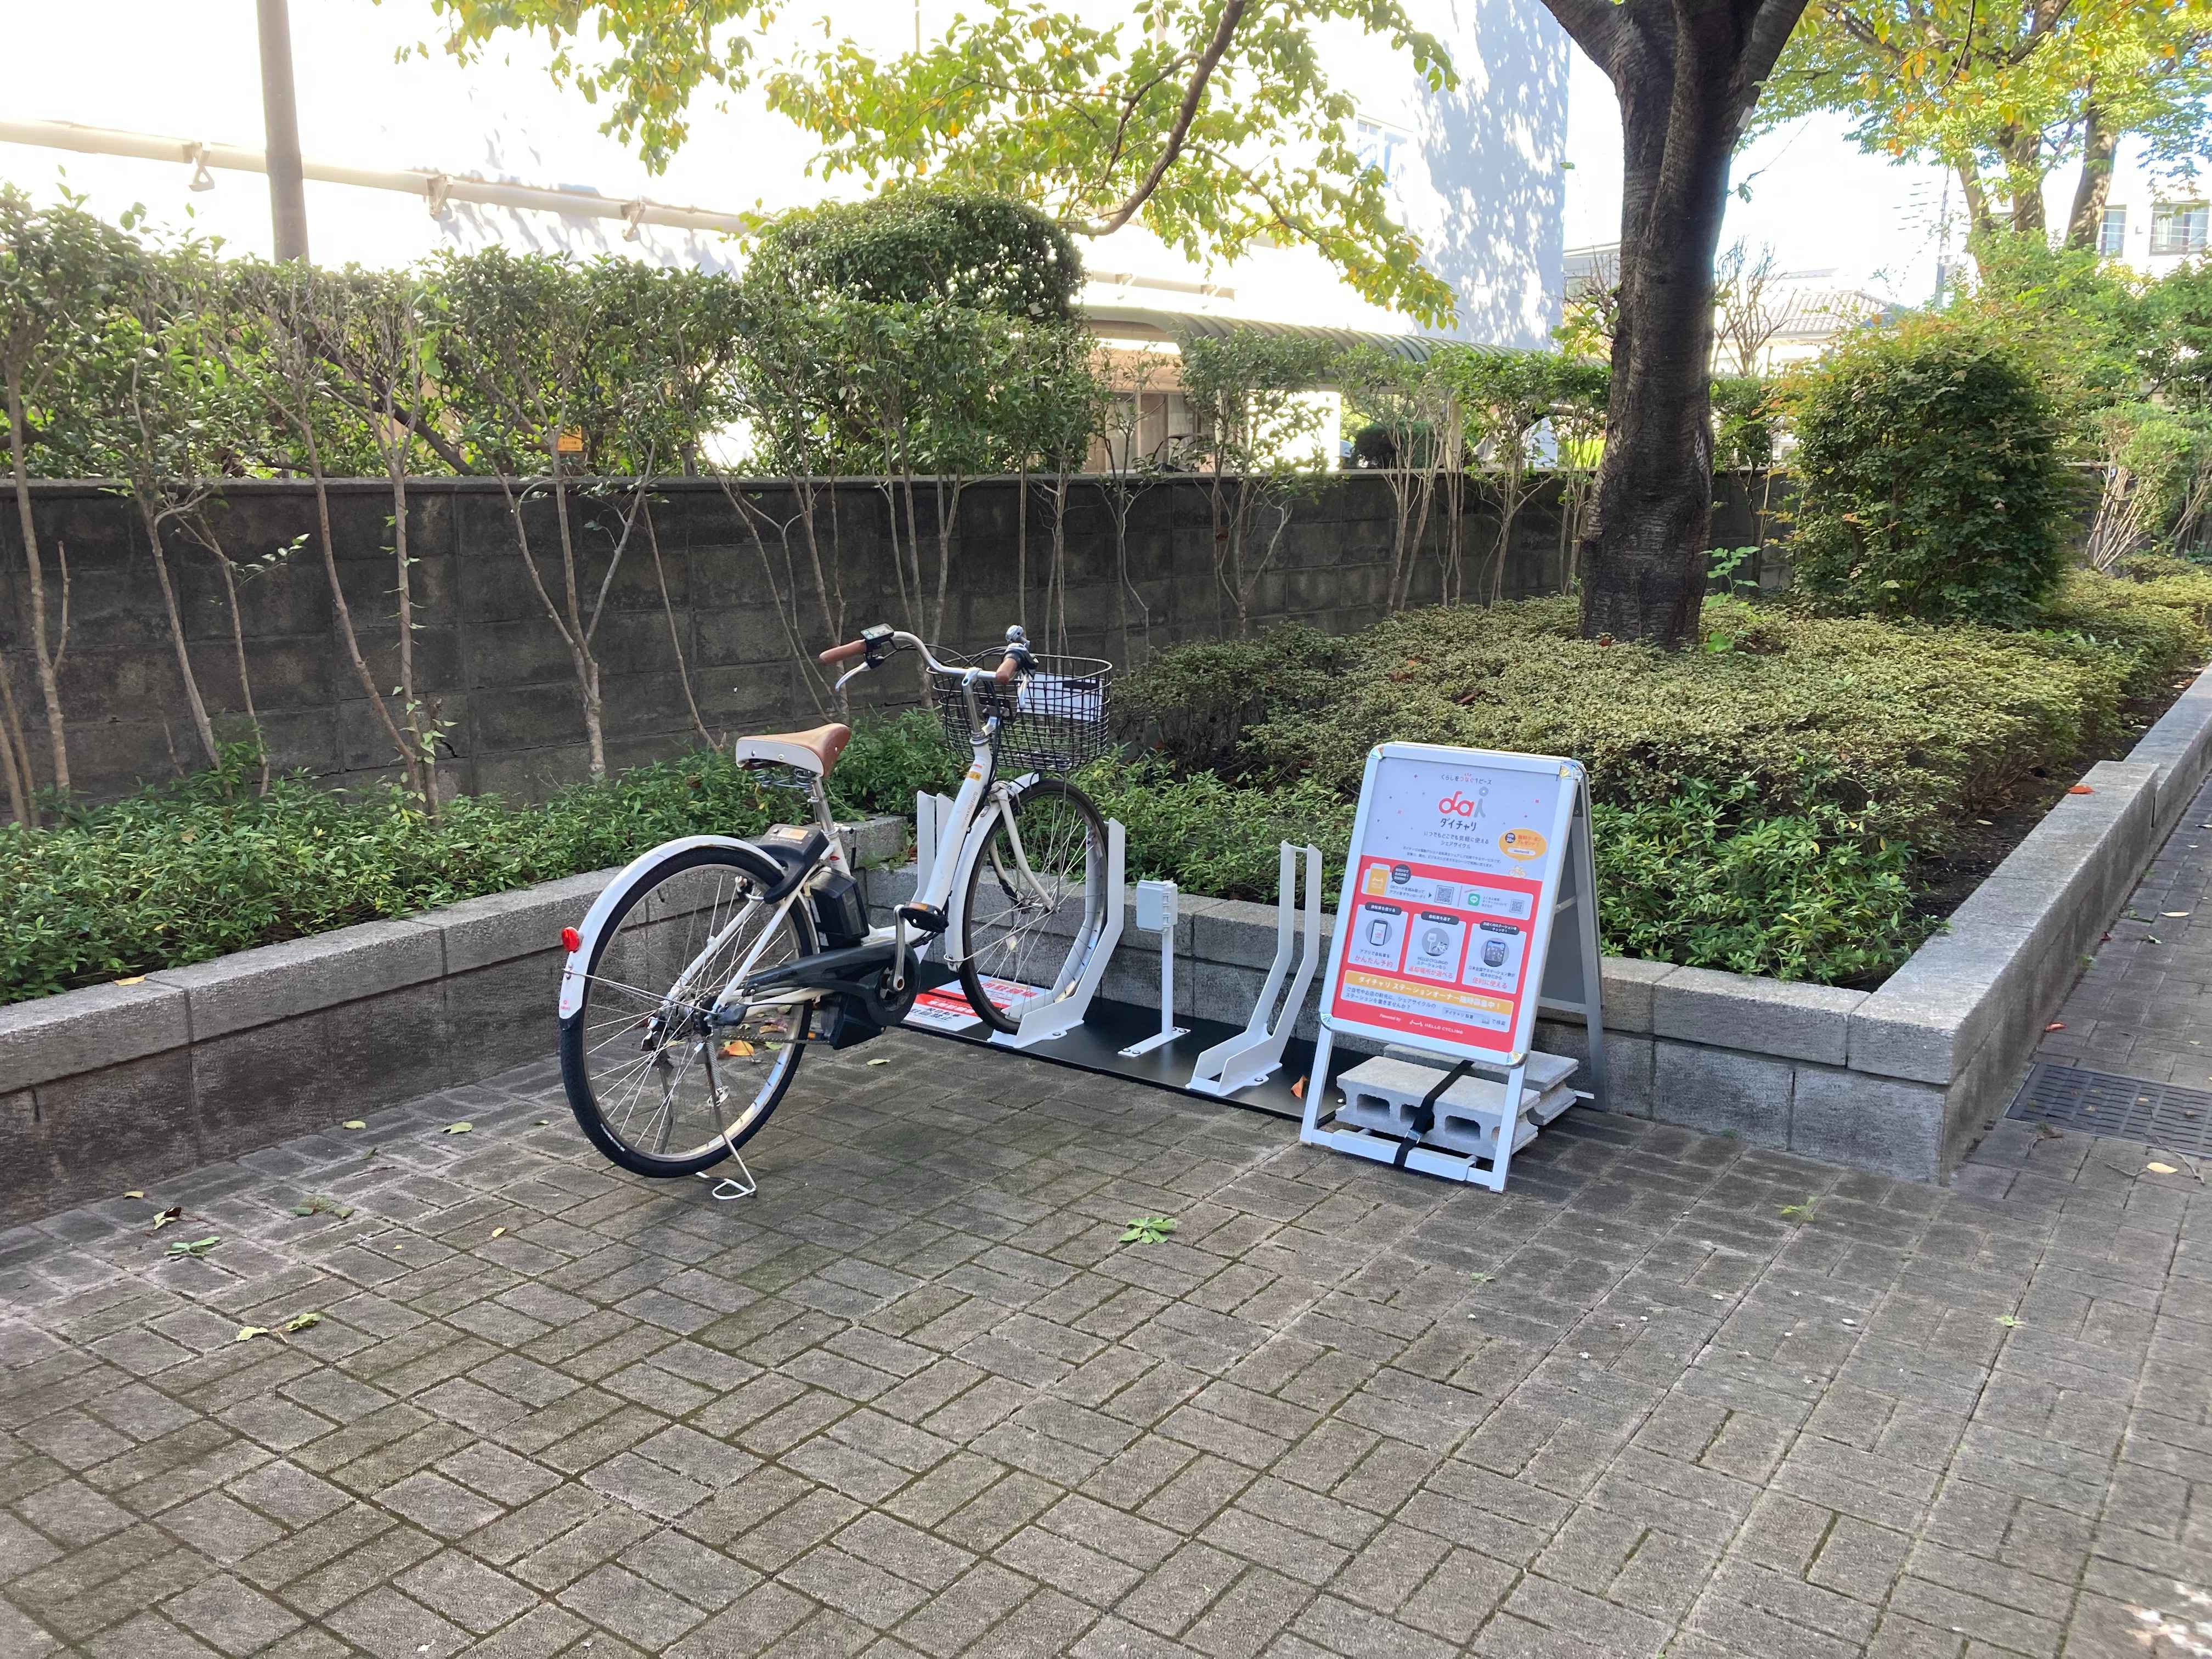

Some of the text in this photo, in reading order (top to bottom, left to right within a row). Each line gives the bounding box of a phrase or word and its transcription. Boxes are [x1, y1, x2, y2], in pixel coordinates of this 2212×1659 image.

[1441, 774, 1492, 785] くらしをつなぐ1ピース
[1438, 817, 1477, 832] ダイチャリ
[1423, 831, 1489, 845] いつでもどこでも気軽に使える
[1440, 840, 1471, 849] シェアサイクル
[1355, 955, 1393, 968] かんたん予約
[1358, 975, 1391, 989] ダイチャリ
[1471, 977, 1508, 990] 便利に使える
[1442, 1026, 1463, 1035] CYCLING
